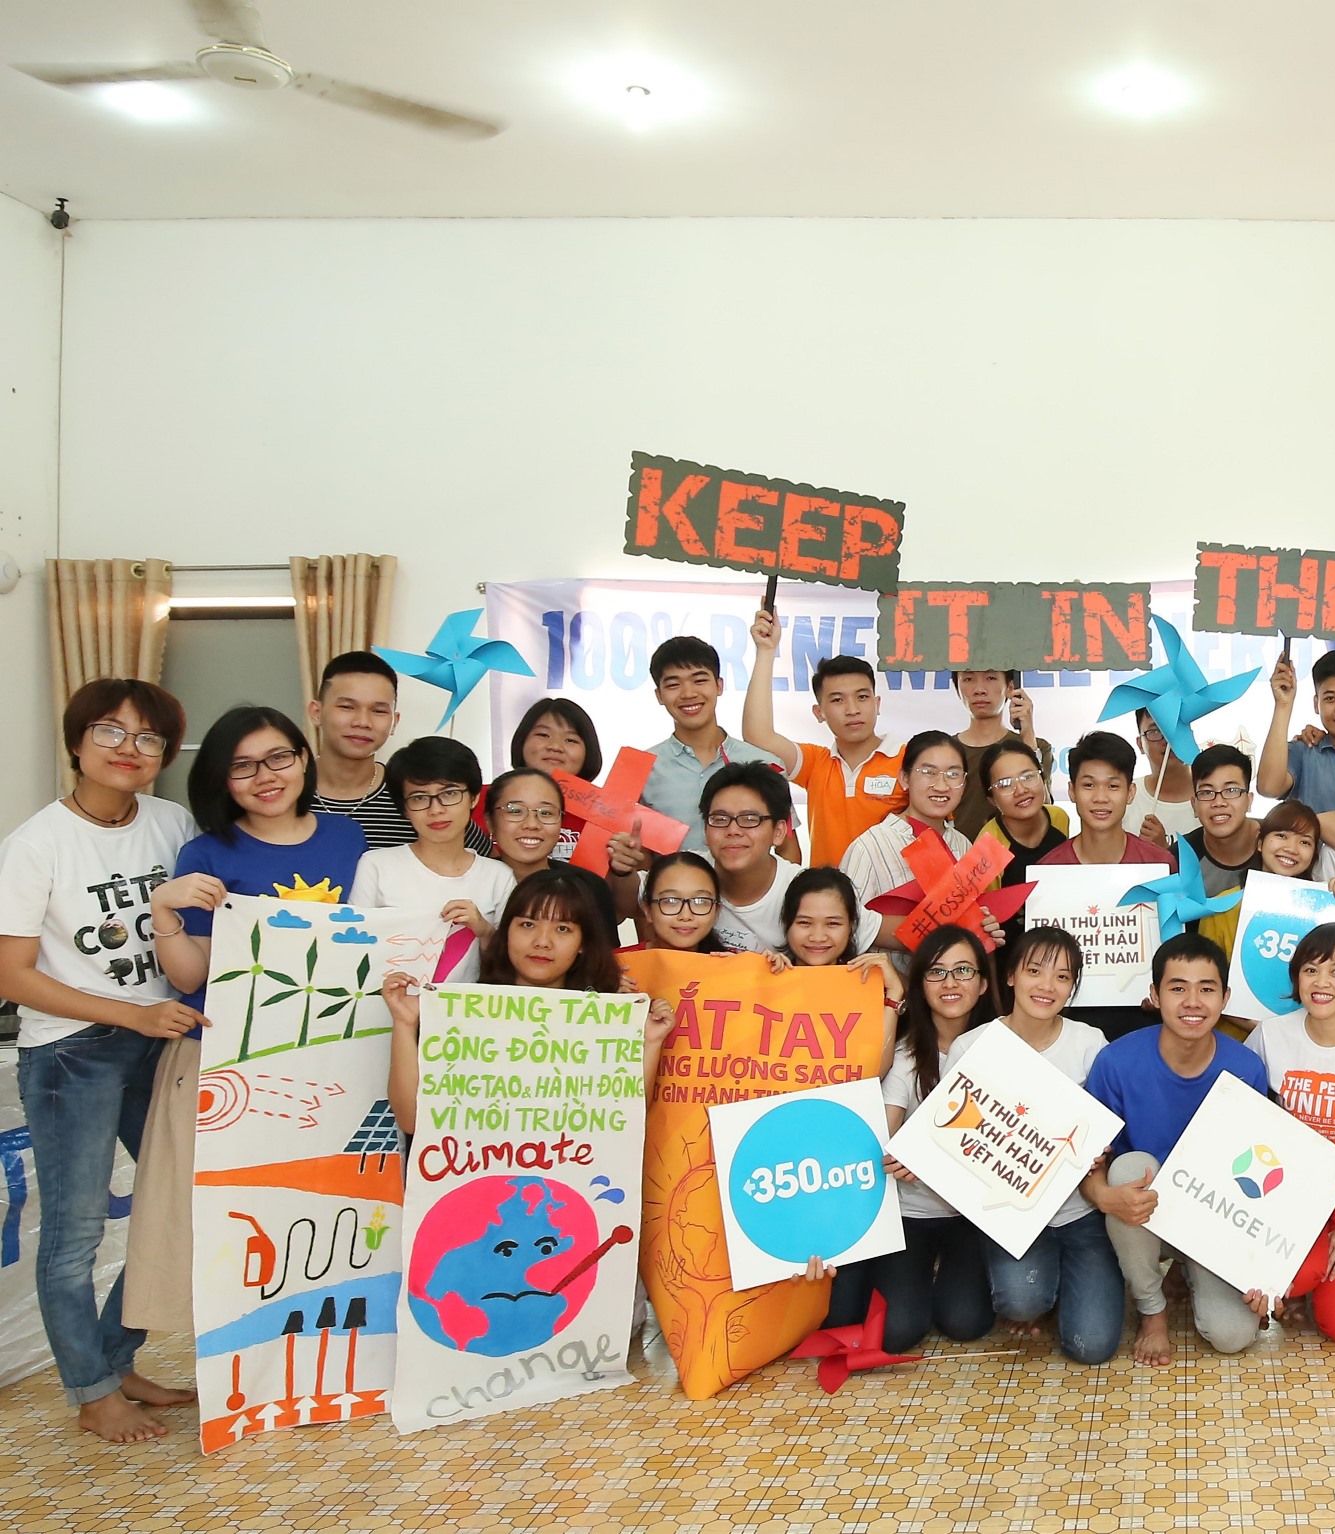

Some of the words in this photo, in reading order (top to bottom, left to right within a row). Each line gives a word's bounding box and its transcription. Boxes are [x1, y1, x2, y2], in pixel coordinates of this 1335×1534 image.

[634, 467, 900, 580] KEEP
[884, 590, 989, 664] IT
[1042, 591, 1147, 663] IN
[1105, 951, 1139, 965] NAM
[438, 991, 552, 1023] TRUNG
[559, 991, 633, 1025] TÂM
[664, 981, 741, 1051] ẮT
[752, 1003, 863, 1059] TAY
[506, 1023, 589, 1064] ĐỒNG
[535, 1067, 594, 1098] HÀNH
[1286, 1077, 1313, 1092] THE
[430, 1099, 462, 1130] VÌ
[464, 1101, 510, 1131] MÔI
[515, 1098, 627, 1133] TRƯỜNG
[749, 1157, 876, 1204] 350.org
[991, 1159, 1030, 1194] NAM
